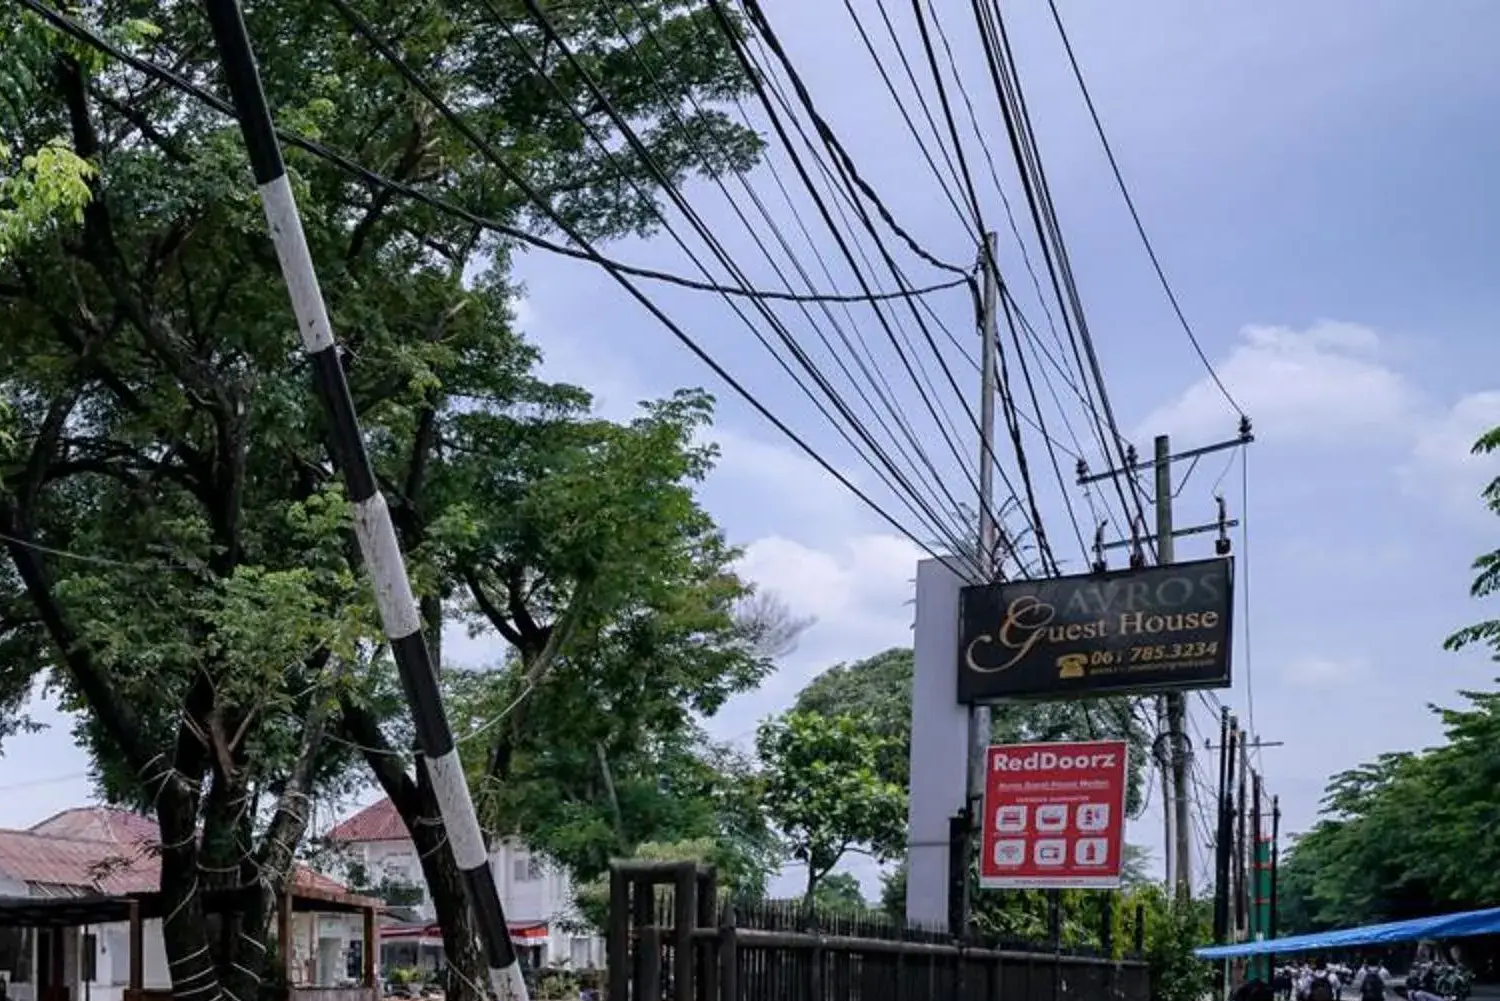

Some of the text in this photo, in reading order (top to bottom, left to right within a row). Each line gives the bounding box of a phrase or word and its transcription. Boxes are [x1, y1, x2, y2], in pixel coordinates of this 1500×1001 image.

[1062, 572, 1220, 616] AVROS
[966, 595, 1219, 672] Guest House
[993, 752, 1116, 771] RedDoorz
